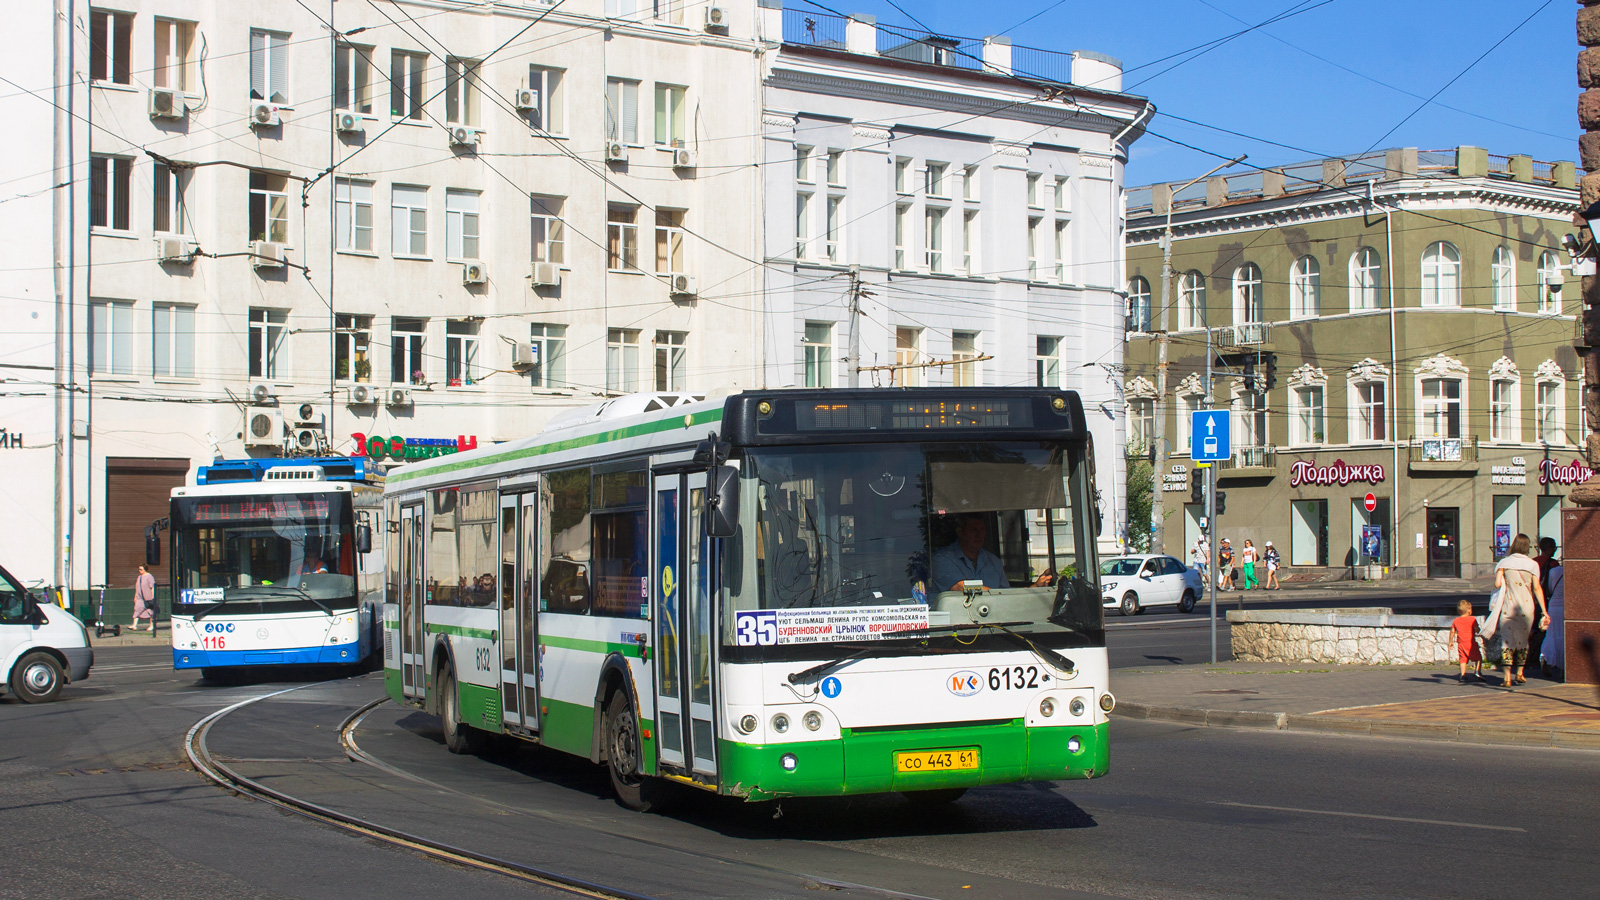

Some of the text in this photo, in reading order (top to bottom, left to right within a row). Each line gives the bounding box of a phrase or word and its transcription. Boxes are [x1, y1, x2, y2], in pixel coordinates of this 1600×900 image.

[1512, 456, 1526, 465] СЕТЬ
[1172, 465, 1187, 473] СЕТЬ
[1290, 459, 1385, 487] Подружка
[1540, 459, 1596, 485] Подруж
[181, 590, 194, 603] 17
[795, 617, 825, 625] СЕЛЬМАШ
[872, 614, 919, 622] КОМСОМОЛЬСКАЯ
[738, 615, 777, 646] 35
[778, 624, 833, 636] БУДЕННОВСКИЙ
[869, 621, 928, 632] ВОРОШИЛОВСКИЙ
[203, 636, 226, 649] 116
[476, 647, 491, 671] 6132
[988, 666, 1039, 691] 6132
[905, 752, 973, 768] СО 443 61
